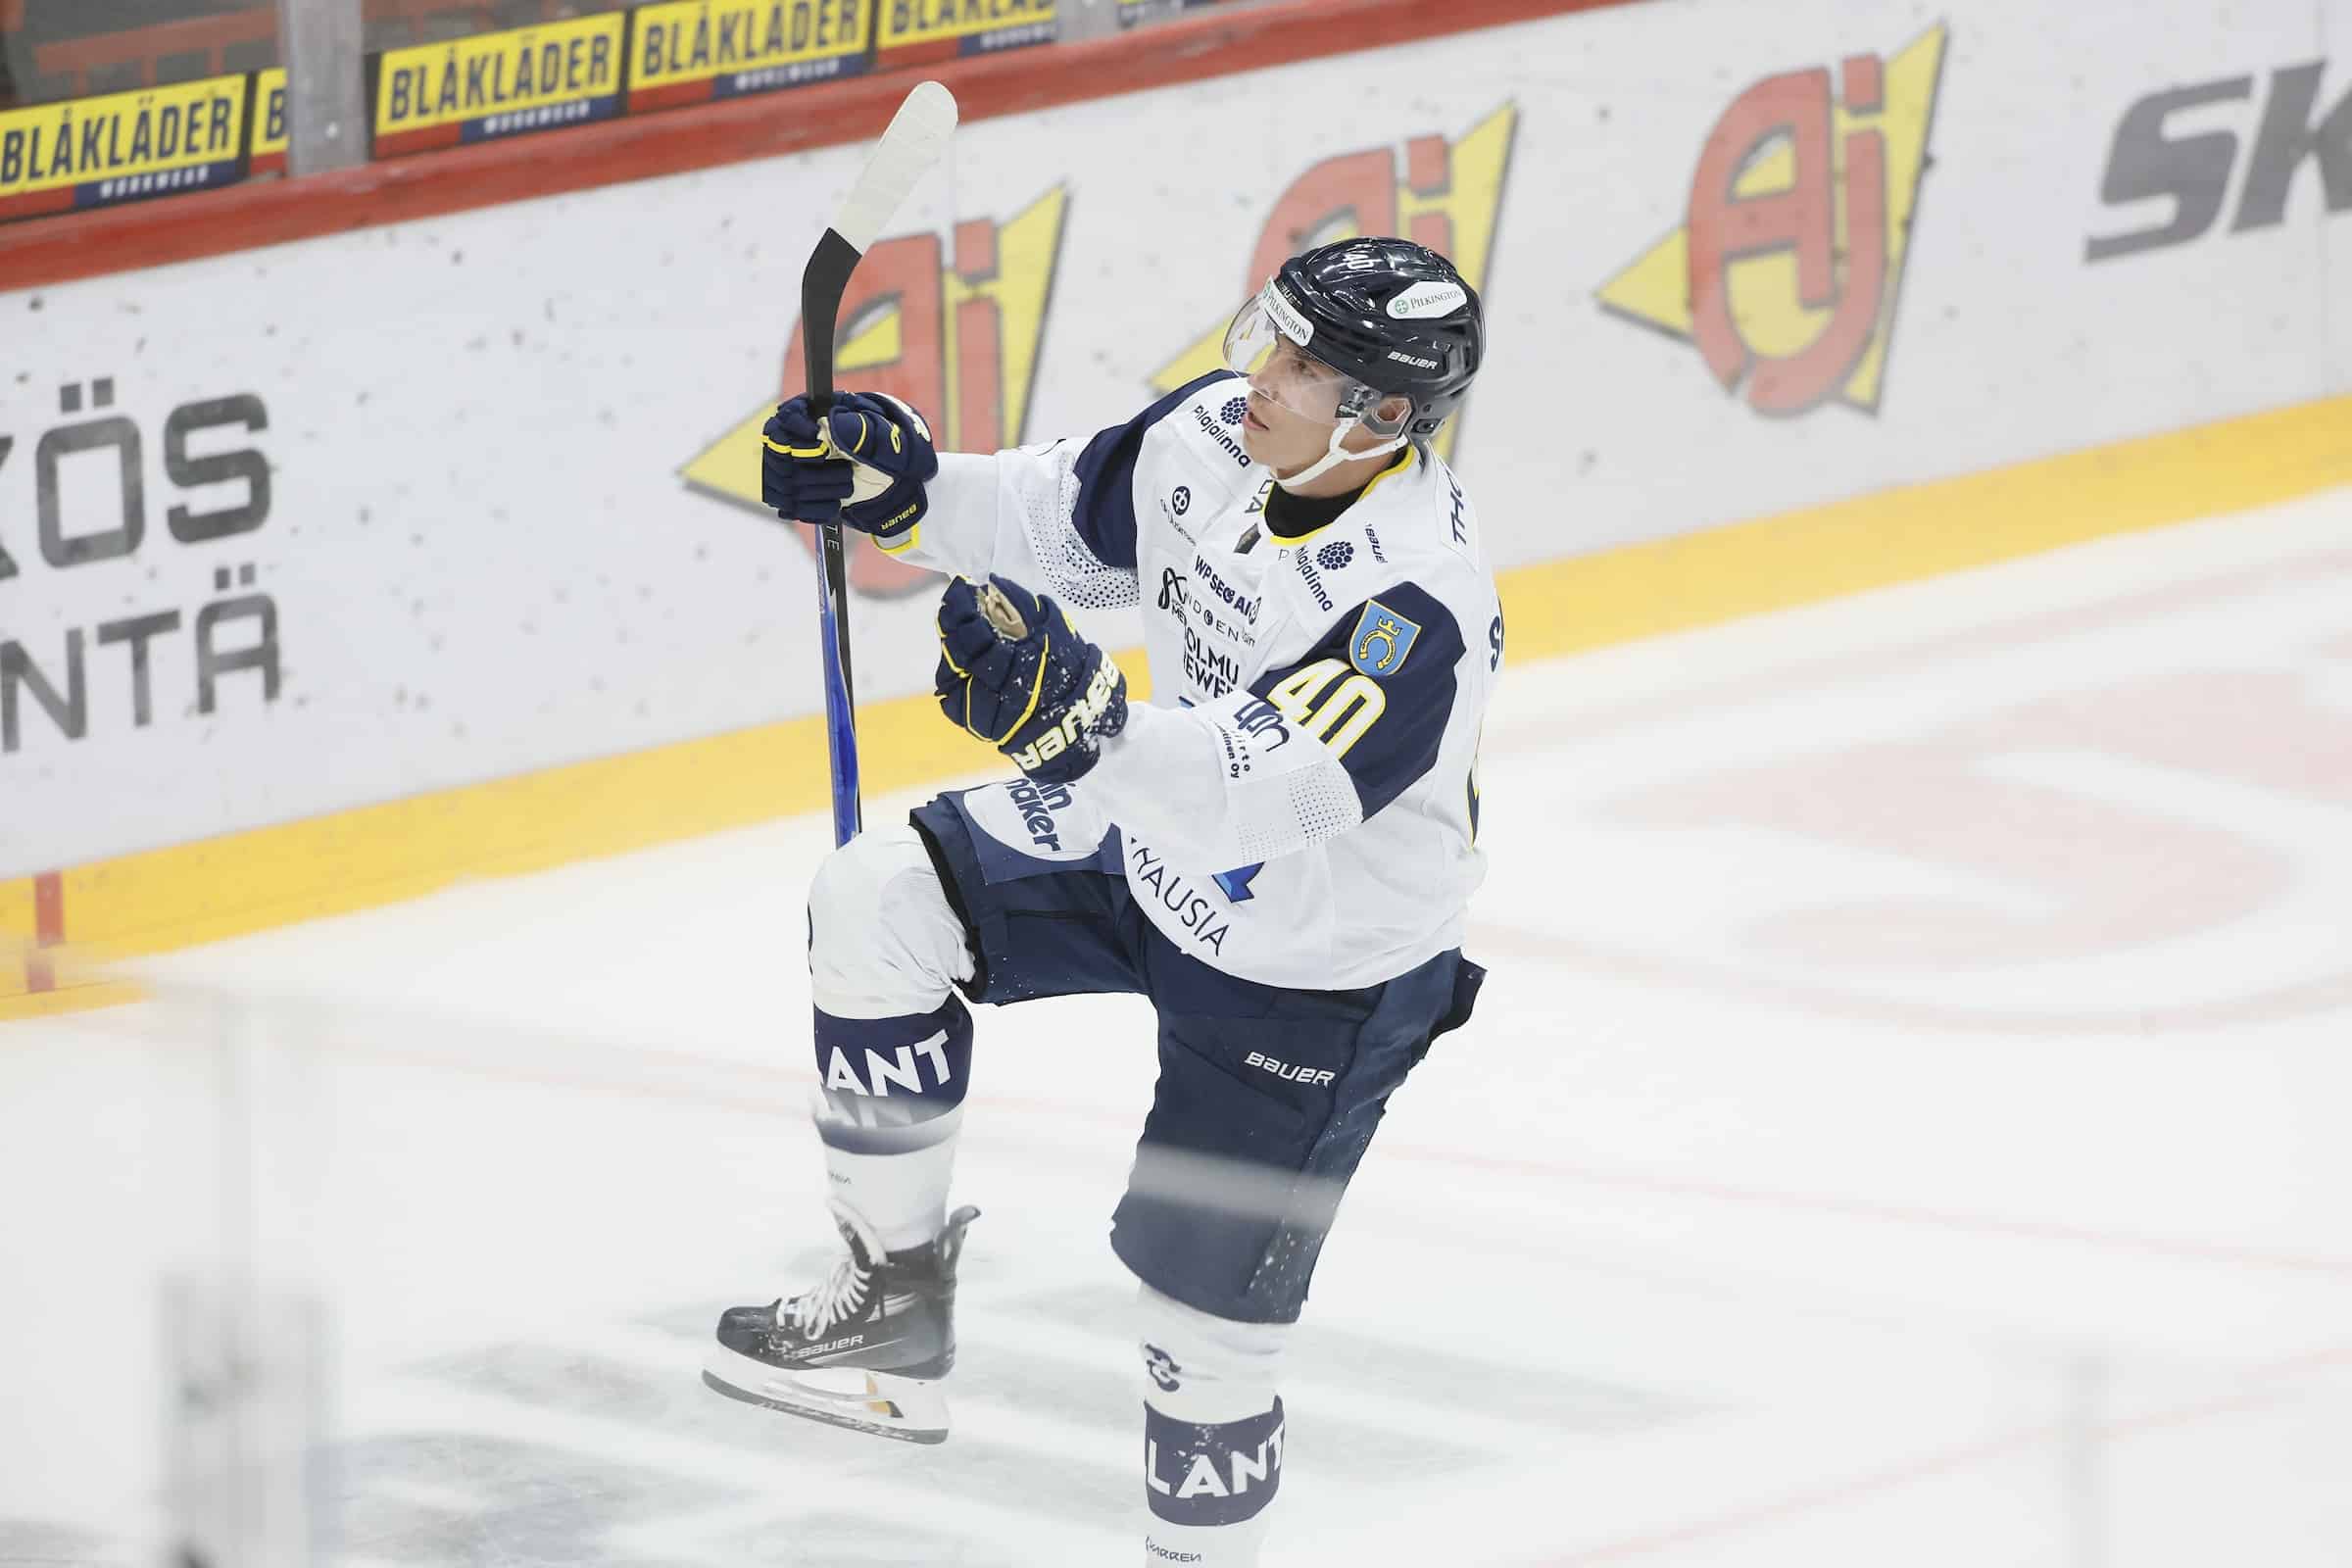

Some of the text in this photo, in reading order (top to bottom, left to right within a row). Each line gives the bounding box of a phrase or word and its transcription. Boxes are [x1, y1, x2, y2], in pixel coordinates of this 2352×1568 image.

[388, 33, 611, 122] BLÅKLÄDER
[1, 96, 233, 184] BLÅKLÄDER
[0, 563, 280, 756] NTÄ
[1266, 658, 1387, 761] 40
